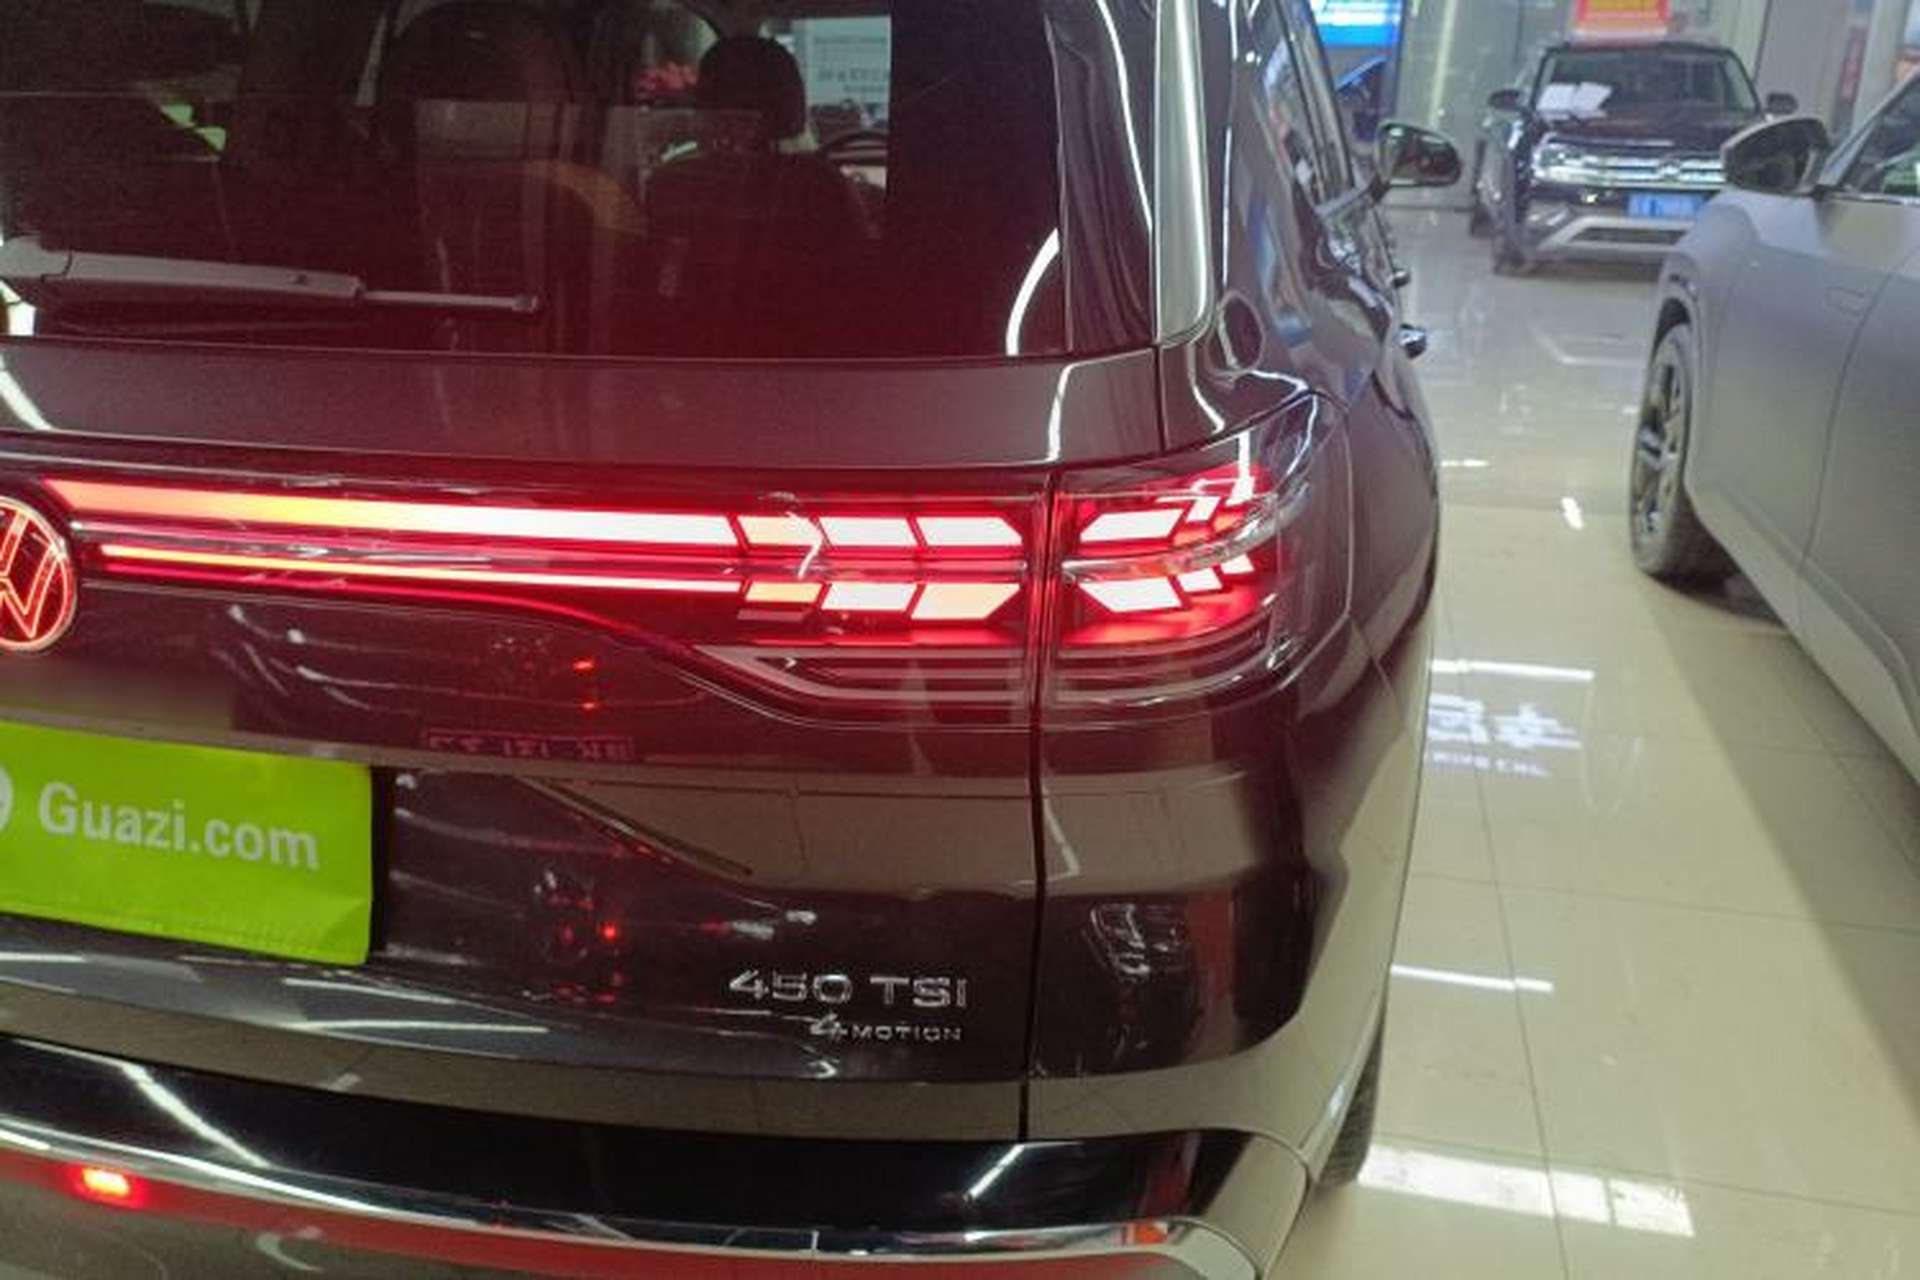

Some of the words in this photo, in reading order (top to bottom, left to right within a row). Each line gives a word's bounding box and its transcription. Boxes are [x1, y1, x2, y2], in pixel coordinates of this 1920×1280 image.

[38, 782, 321, 871] Guazi.com
[728, 969, 852, 1004] 450
[869, 973, 967, 1008] TSI
[809, 1012, 962, 1042] 4MOTION
